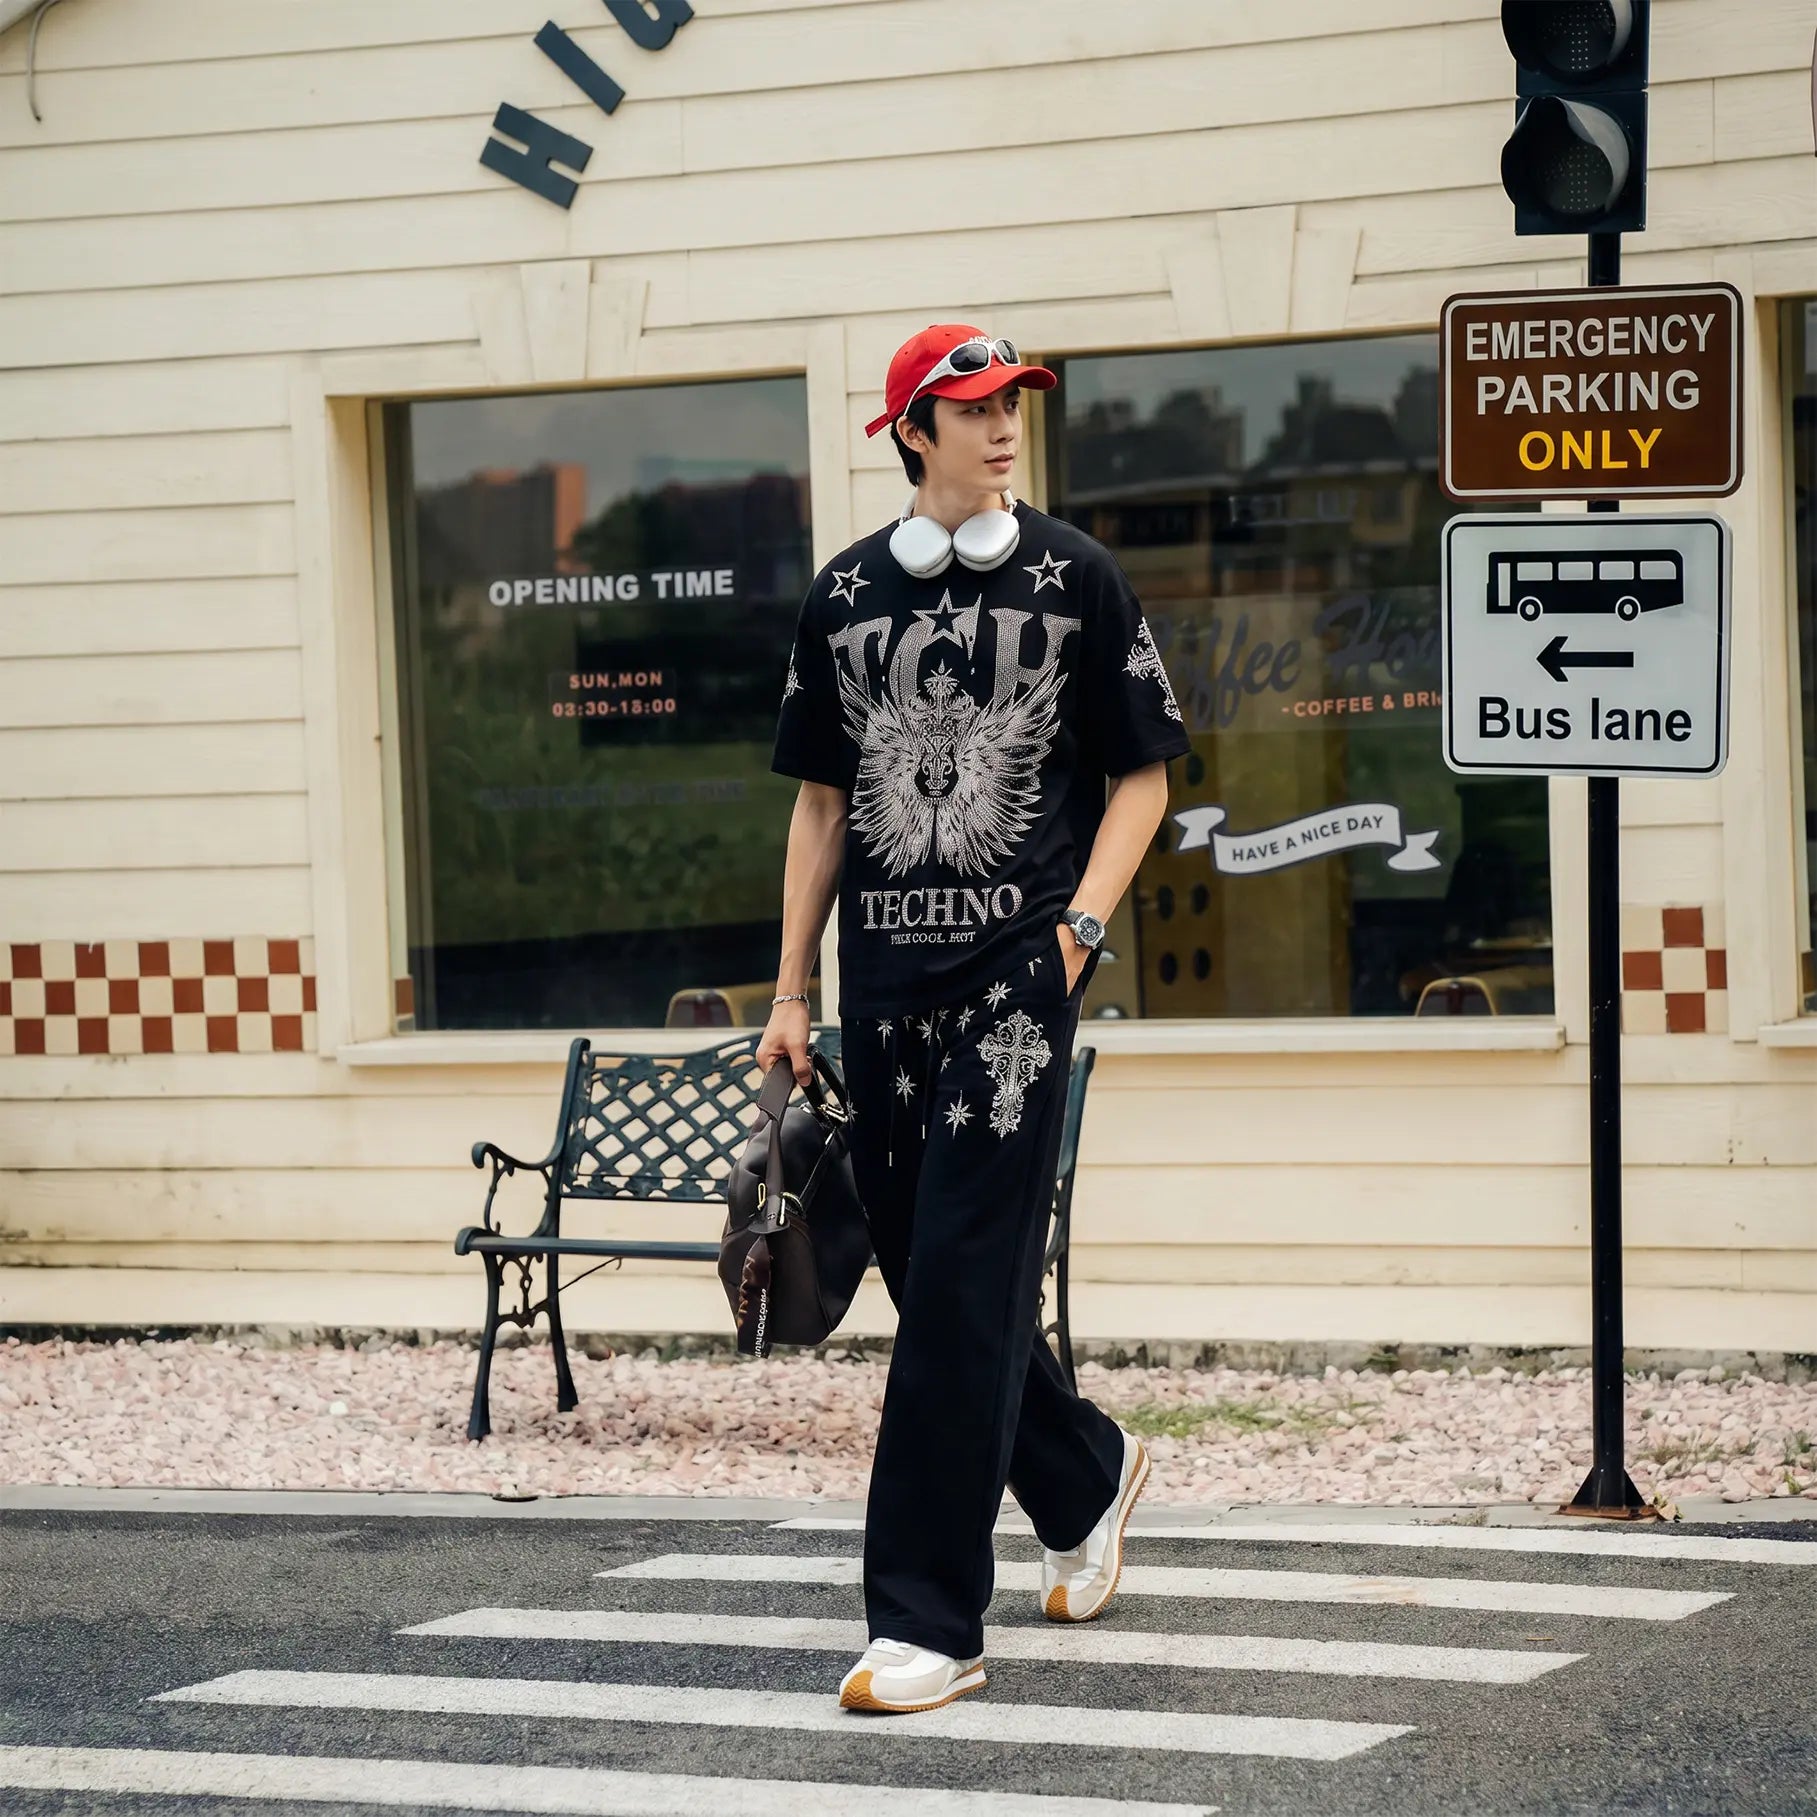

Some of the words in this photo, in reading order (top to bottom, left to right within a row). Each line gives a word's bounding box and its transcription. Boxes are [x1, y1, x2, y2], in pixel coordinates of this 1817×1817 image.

[1466, 313, 1716, 361] EMERGENCY
[1477, 369, 1700, 415] PARKING
[1518, 428, 1663, 471] ONLY
[488, 574, 641, 607] OPENING
[651, 569, 735, 599] TIME
[1381, 694, 1396, 711] &
[1479, 696, 1572, 740] Bus
[1591, 697, 1693, 742] lane
[1232, 841, 1281, 863] HAVE
[1285, 836, 1298, 851] A
[1301, 820, 1342, 846] NICE
[1346, 815, 1384, 832] DAY
[860, 883, 1023, 930] TECHNO
[912, 932, 946, 944] COOL
